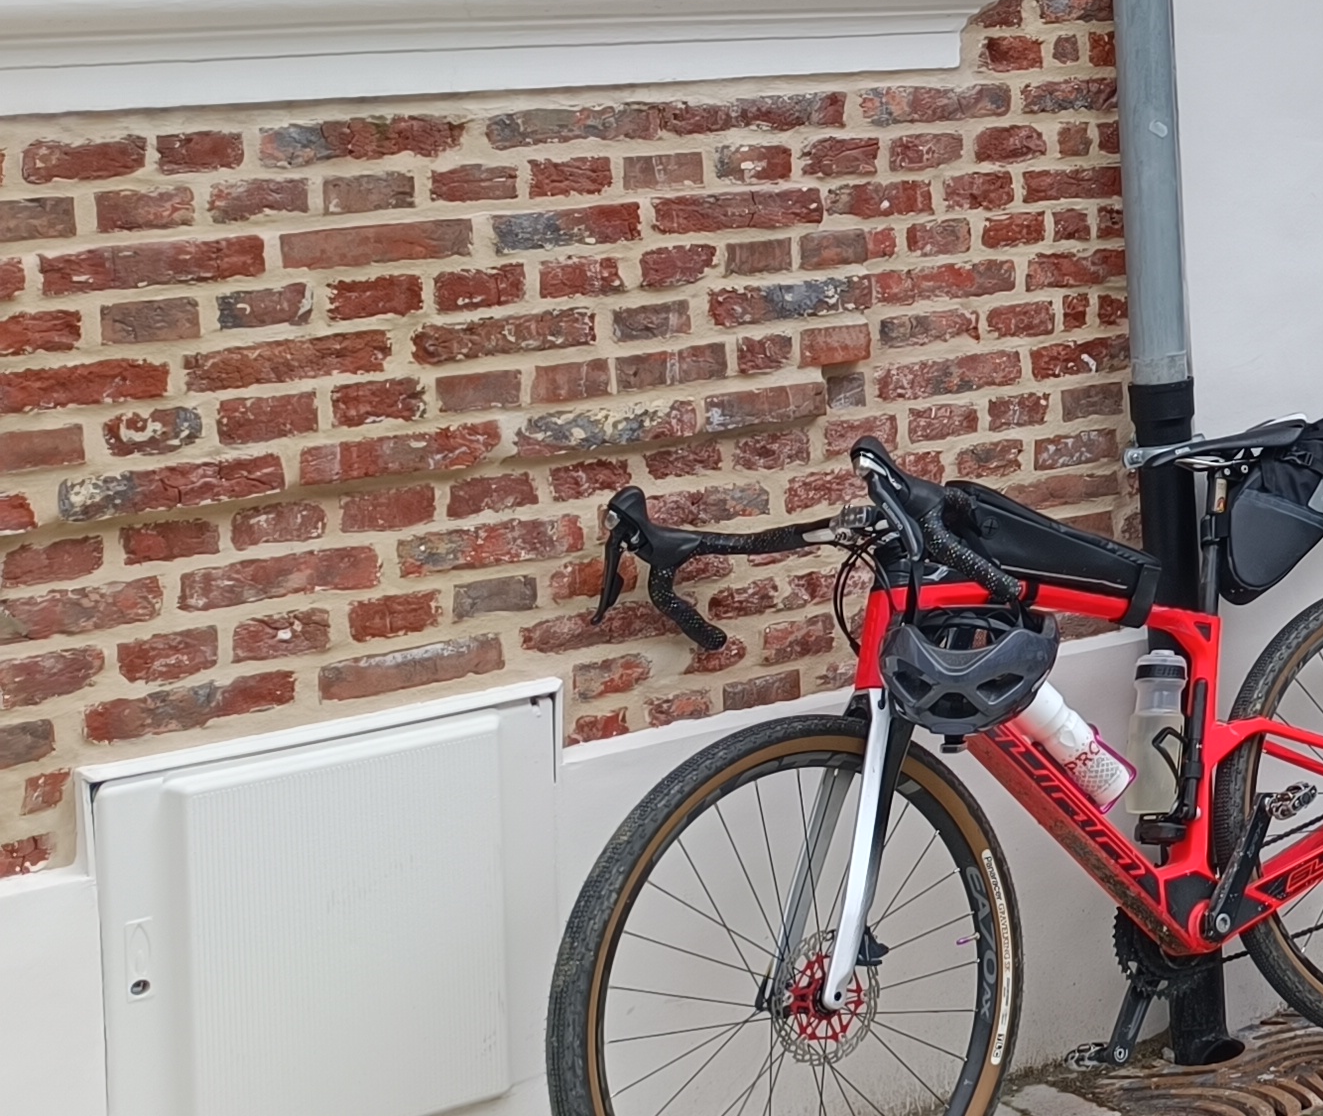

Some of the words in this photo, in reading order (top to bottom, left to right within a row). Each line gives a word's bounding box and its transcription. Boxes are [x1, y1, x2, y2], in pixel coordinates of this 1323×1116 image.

[983, 855, 1003, 901] Panaracer
[966, 866, 998, 984] EA70
[980, 983, 991, 1018] AX
